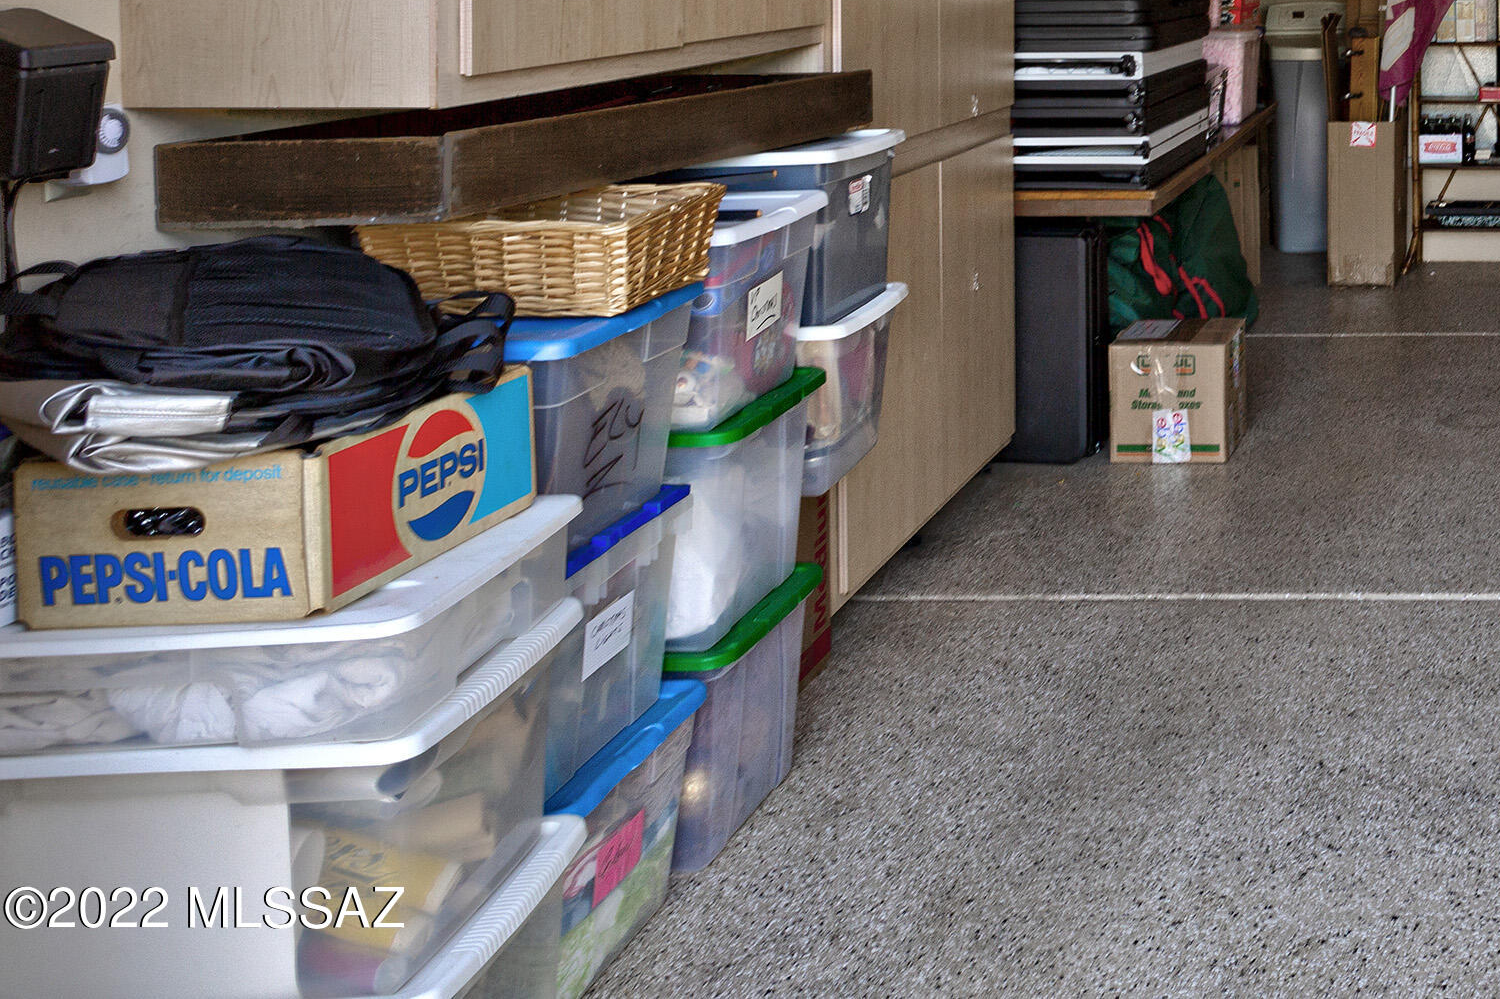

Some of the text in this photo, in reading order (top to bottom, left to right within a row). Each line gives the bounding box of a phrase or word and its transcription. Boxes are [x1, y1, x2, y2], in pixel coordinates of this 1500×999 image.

[149, 471, 197, 486] return
[199, 468, 223, 483] for
[223, 464, 283, 484] deposit
[398, 438, 485, 509] PEPSI
